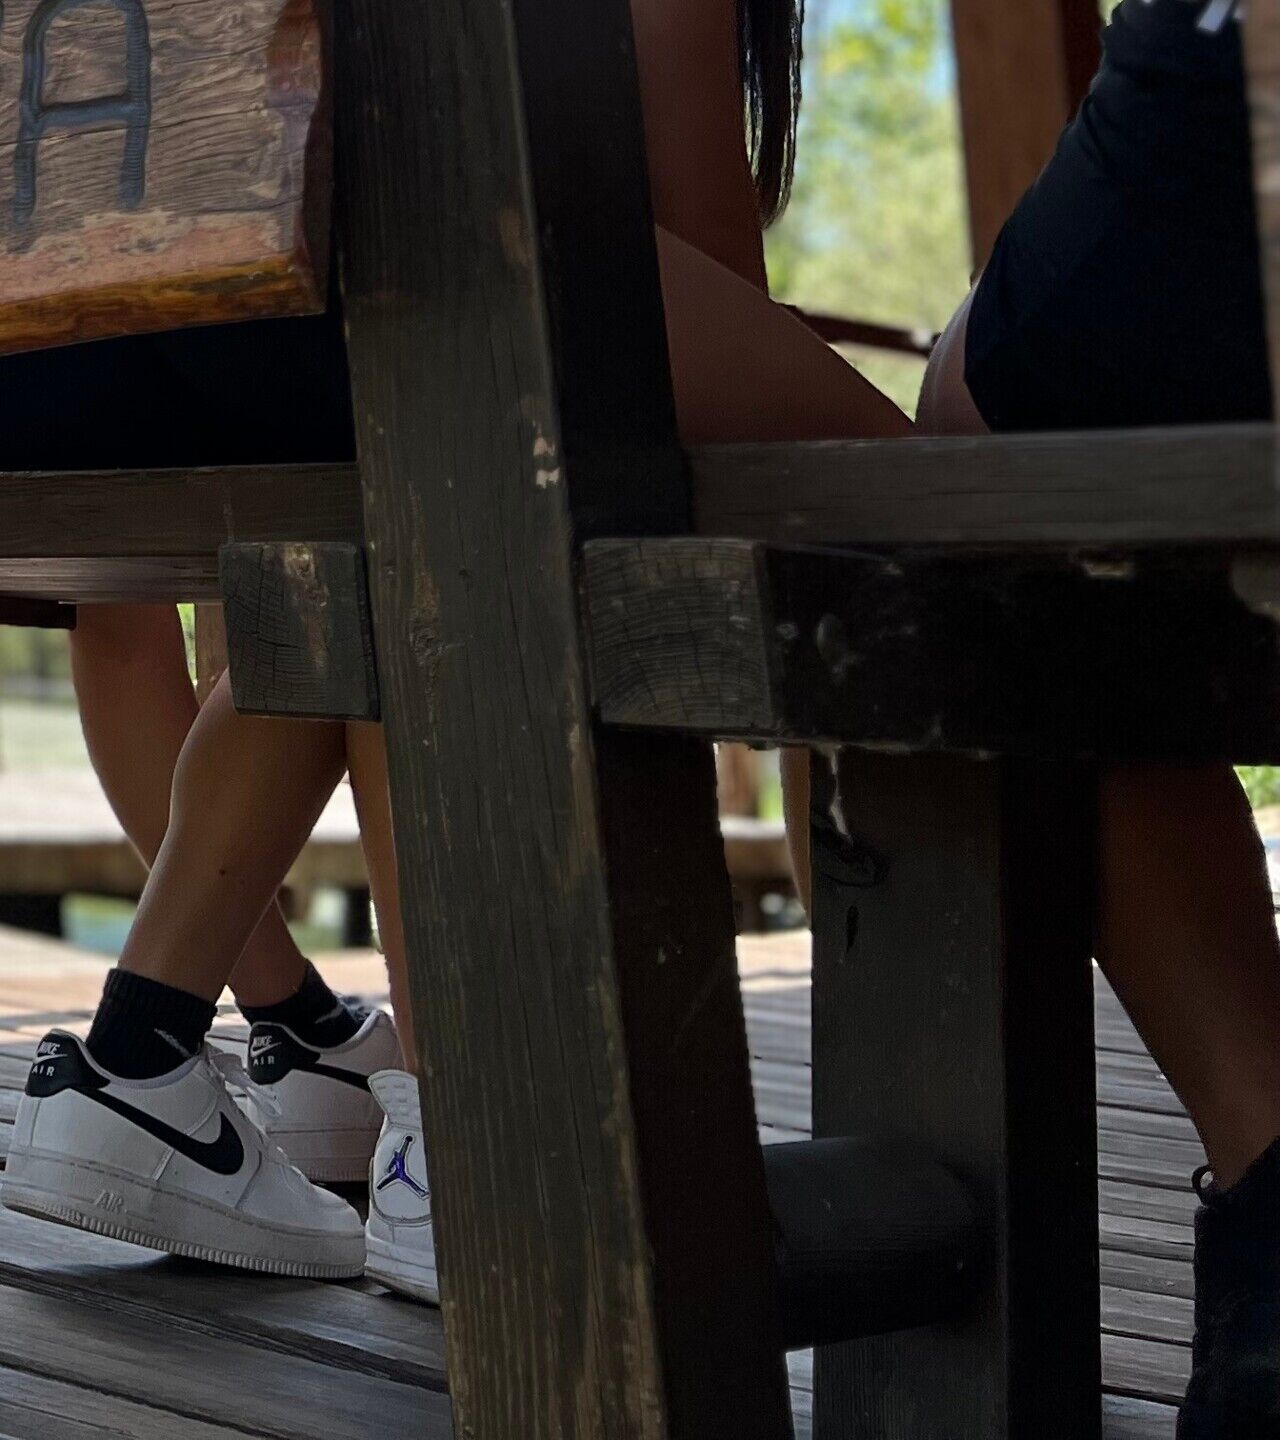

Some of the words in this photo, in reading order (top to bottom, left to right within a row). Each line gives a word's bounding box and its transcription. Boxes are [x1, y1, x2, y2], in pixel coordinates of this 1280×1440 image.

[39, 1040, 61, 1056] NIKE
[252, 1054, 276, 1067] AIR
[31, 1064, 56, 1078] AIR
[94, 1188, 124, 1215] AIR
